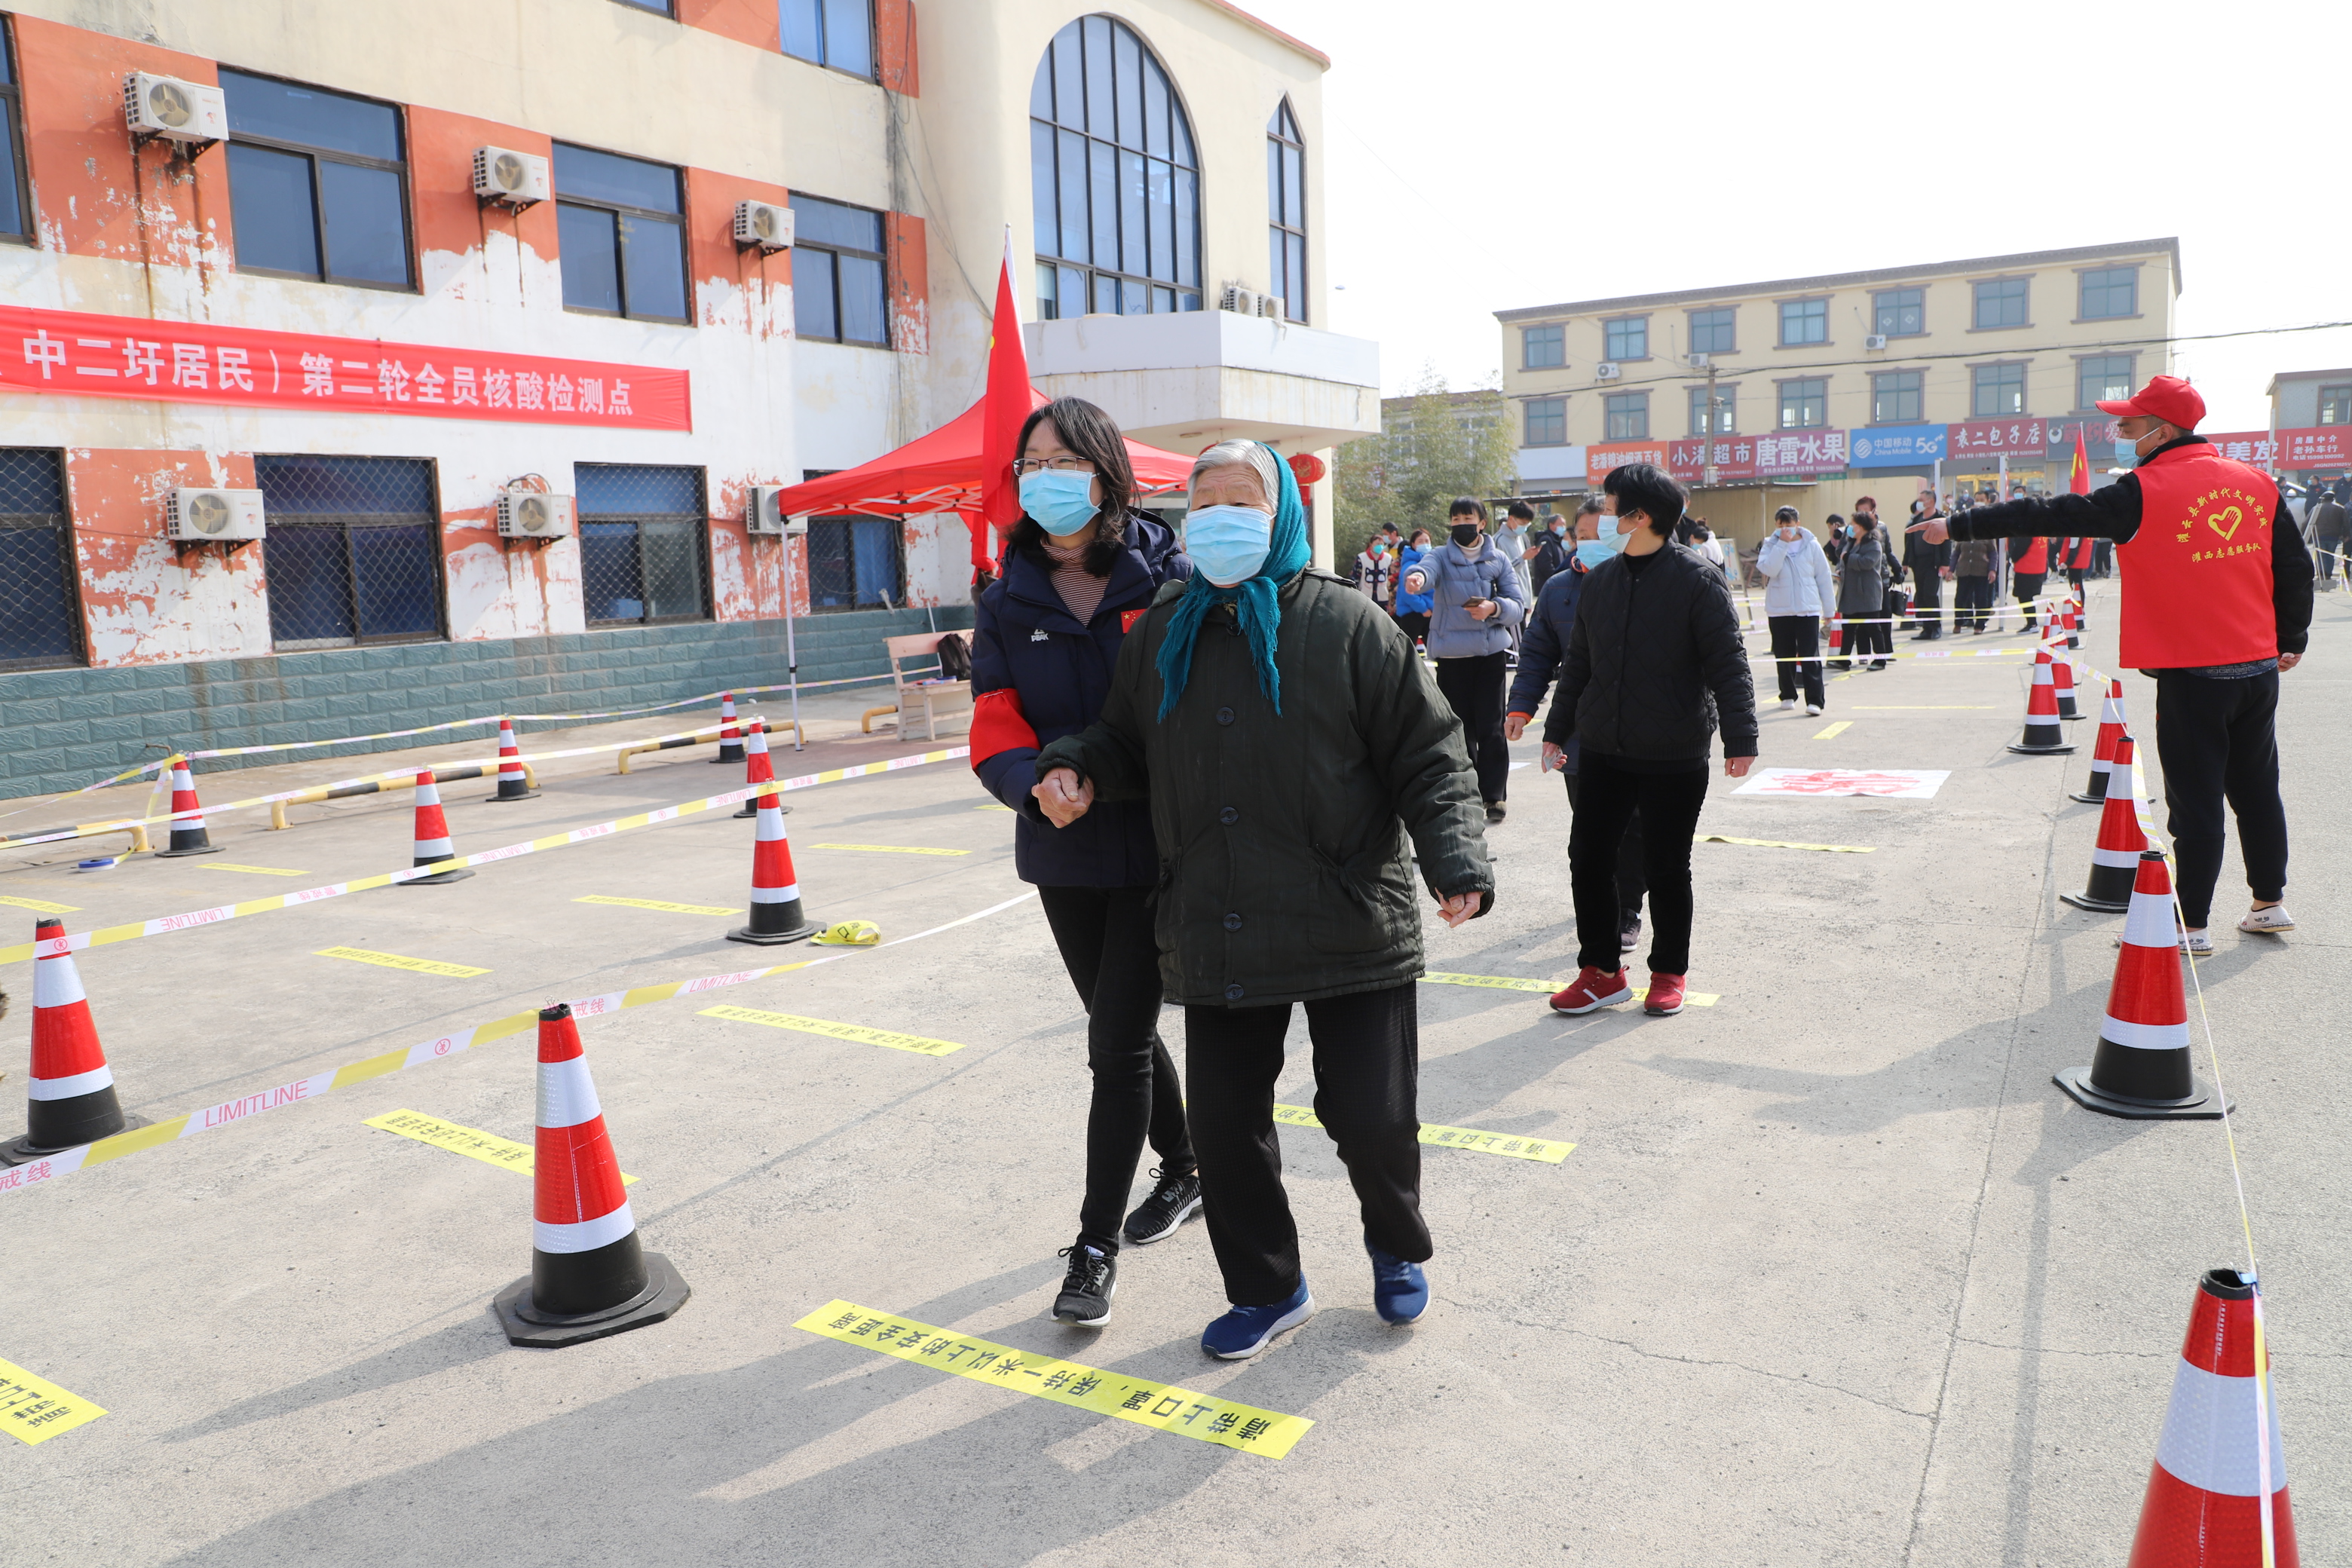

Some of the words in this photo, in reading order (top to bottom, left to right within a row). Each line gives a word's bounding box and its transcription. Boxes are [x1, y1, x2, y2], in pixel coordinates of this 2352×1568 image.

[0, 329, 634, 416] 中二圩居民）第二轮全员核酸检测点
[1874, 436, 1912, 449] 中国移动
[1954, 422, 2041, 449] 袁二包子店
[2295, 434, 2338, 445] 房屋中介
[1671, 442, 1752, 466] 小潘超市
[1755, 433, 1845, 467] 唐雷水果
[1892, 446, 1912, 455] Mobile
[2293, 444, 2338, 455] 老孙车行
[2176, 487, 2269, 544] 灌云县新时代文明实践
[2191, 542, 2262, 563] 灌西志愿服务队
[1031, 632, 1049, 642] PEAK
[715, 789, 752, 807] LIMITLINE
[478, 844, 528, 863] LIMITLINE
[297, 885, 337, 902] 警戒线
[160, 907, 225, 932] LIMITLINE
[689, 969, 755, 994] LIMITLINE
[565, 998, 605, 1018] 戒线
[204, 1080, 309, 1129] LIMITLINE
